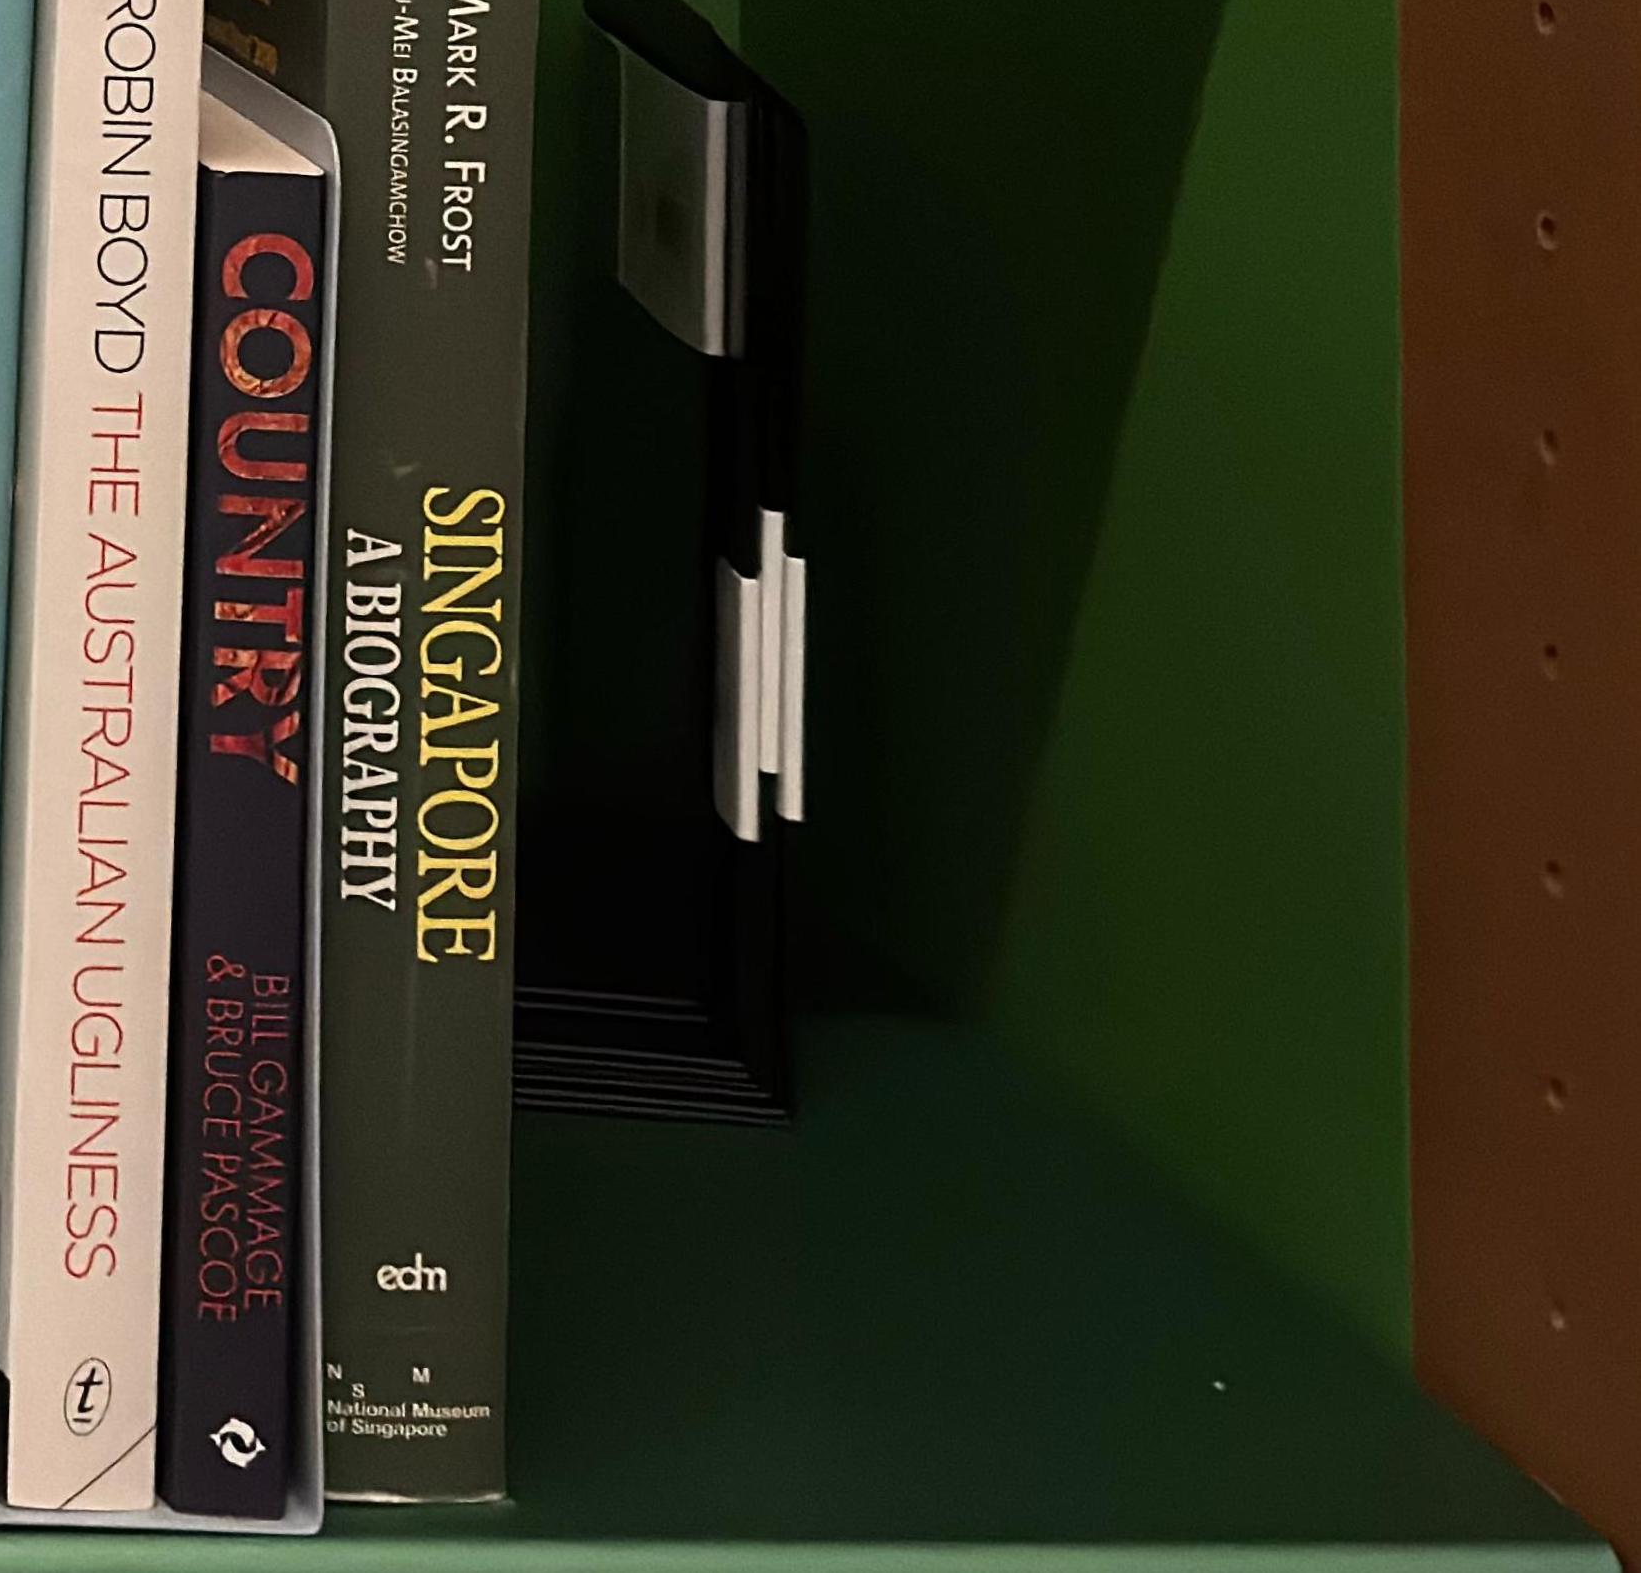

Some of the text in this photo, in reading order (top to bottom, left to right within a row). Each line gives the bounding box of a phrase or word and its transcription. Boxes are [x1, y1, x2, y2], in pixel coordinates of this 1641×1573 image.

[444, 103, 487, 143] R.
[93, 193, 149, 375] BOYD
[87, 392, 145, 518] THE
[210, 233, 313, 786] COUNTRY
[74, 532, 135, 945] AUSTRALIAN
[340, 529, 402, 912] A BIOGRAPHY
[416, 488, 504, 964] SINGAPORE
[62, 965, 124, 1281] UGLINESS
[198, 955, 244, 1324] & BRUCE PASCOE
[246, 973, 291, 1309] BILL GAMMAGE
[377, 1253, 447, 1291] edm
[326, 1418, 447, 1439] of Singapore
[327, 1363, 430, 1383] N M
[327, 1400, 490, 1418] National Museum
[352, 1383, 365, 1398] S
